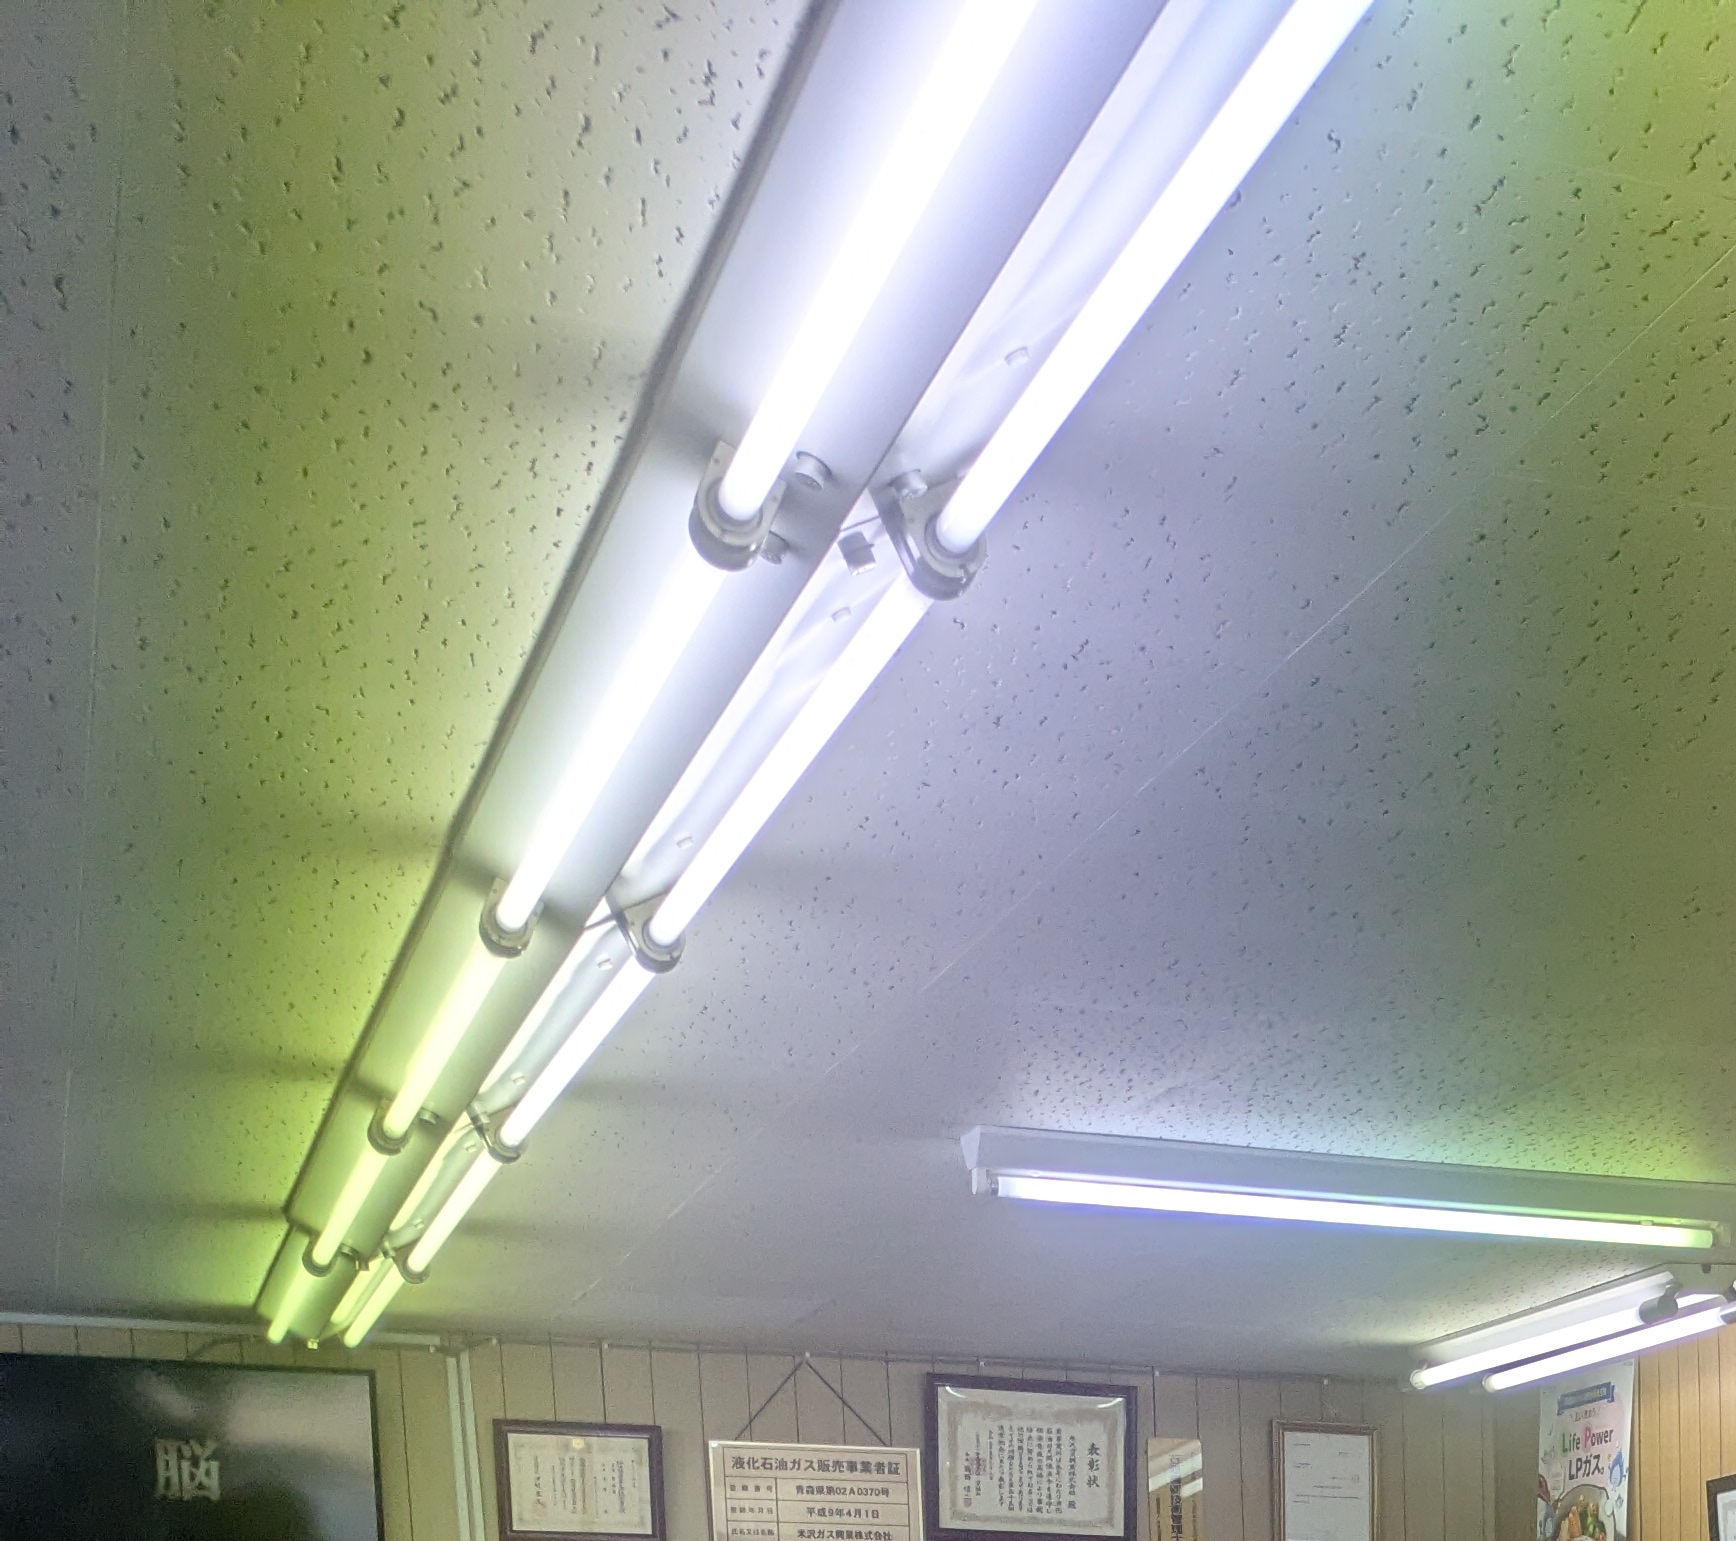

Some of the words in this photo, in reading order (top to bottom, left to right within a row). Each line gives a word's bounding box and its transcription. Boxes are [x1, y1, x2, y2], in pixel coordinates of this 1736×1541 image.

[1562, 1432, 1581, 1454] Life
[1583, 1426, 1614, 1451] Power
[731, 1455, 901, 1475] 液化石油ガス販売事業者証
[1087, 1442, 1101, 1489] 表彰状
